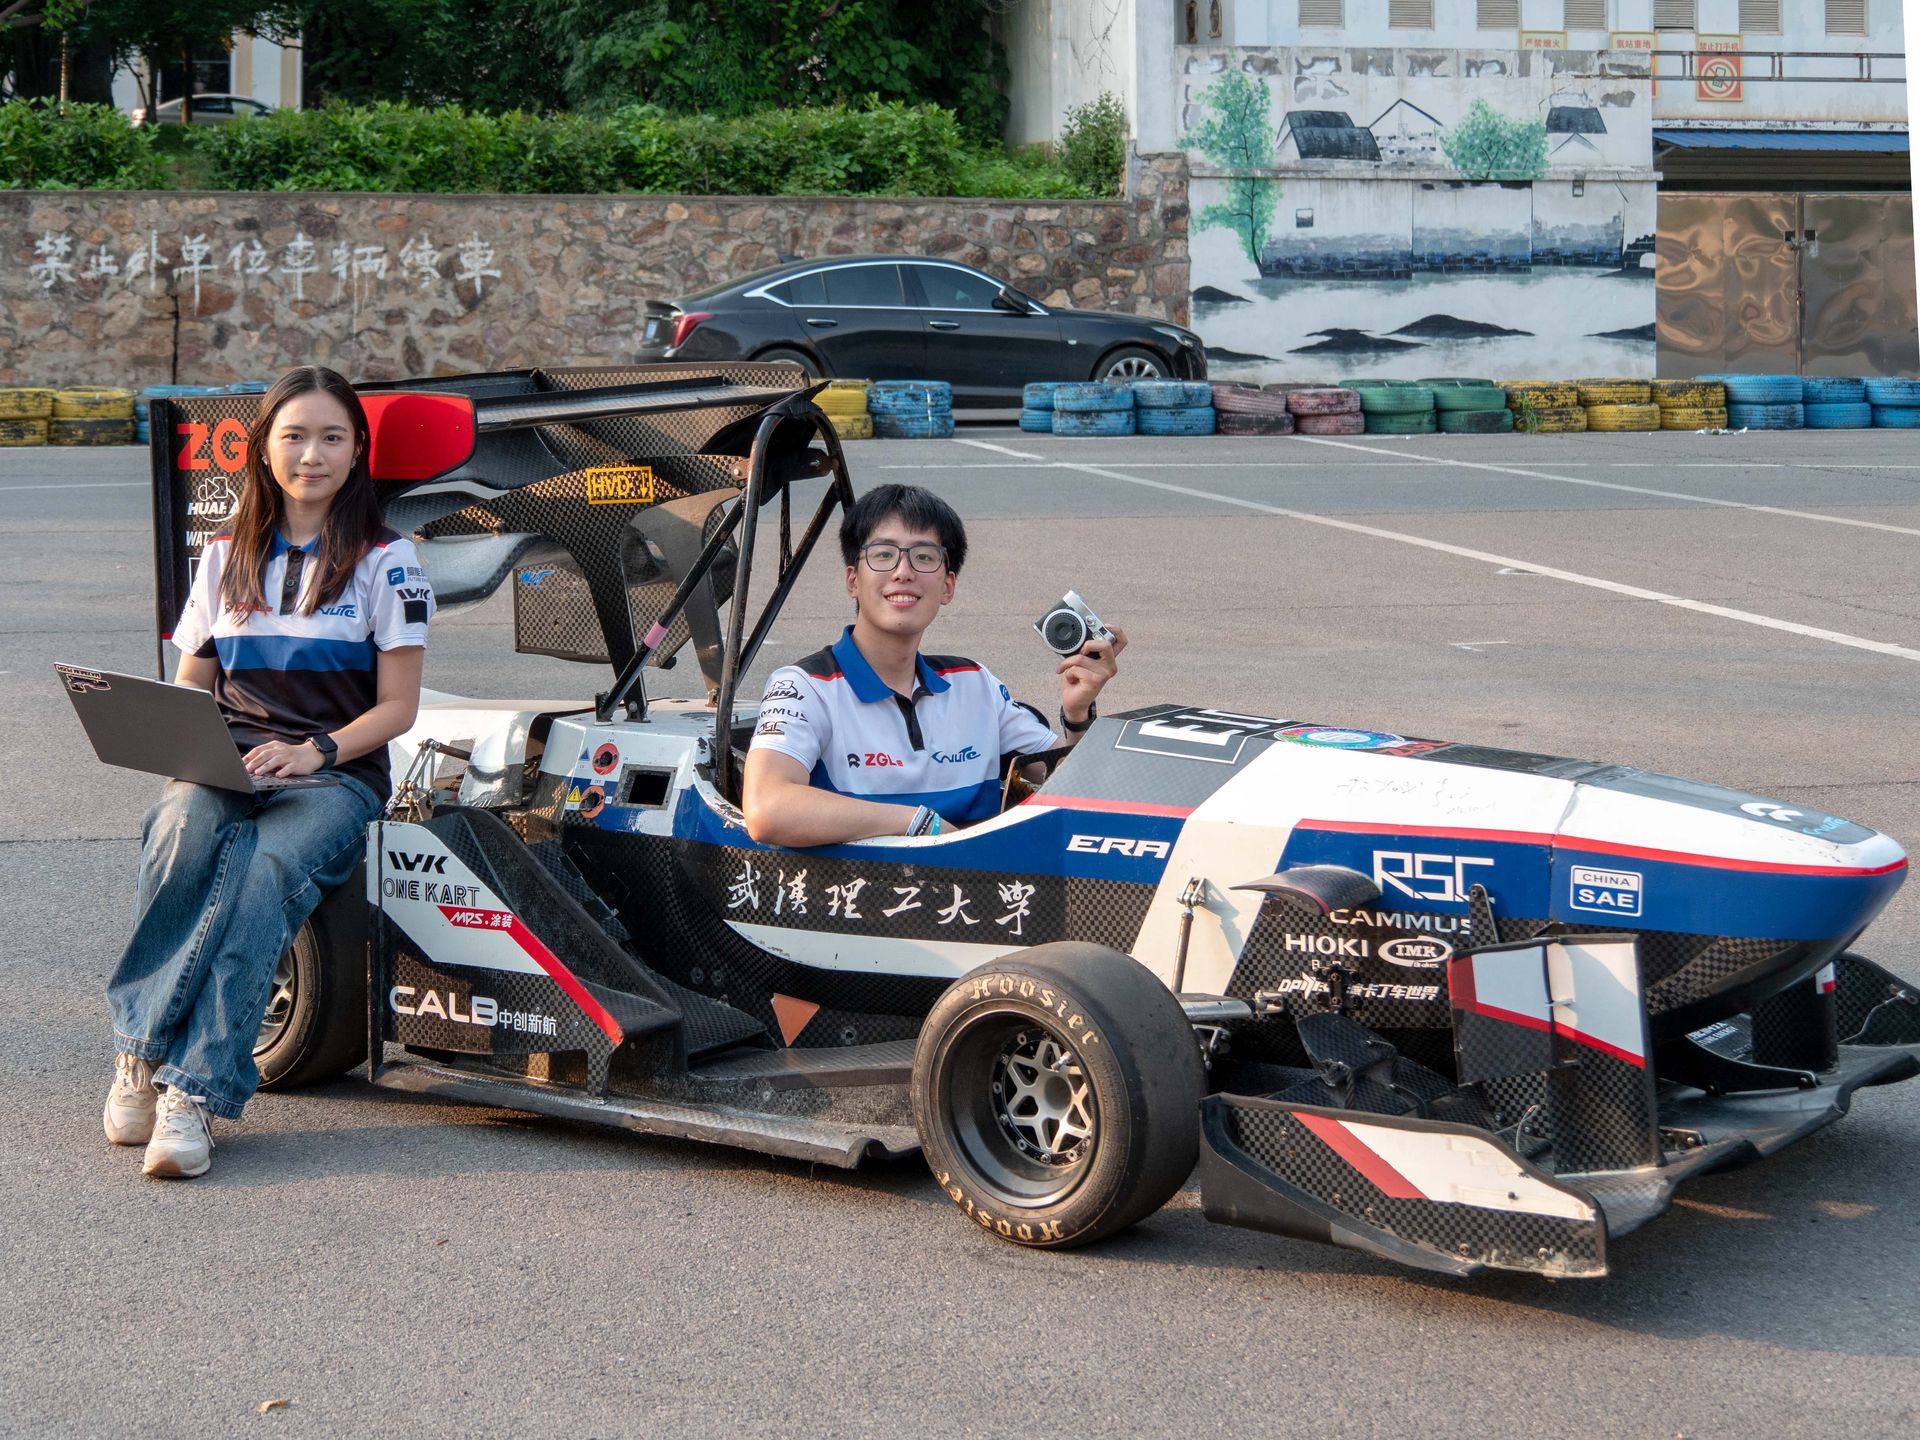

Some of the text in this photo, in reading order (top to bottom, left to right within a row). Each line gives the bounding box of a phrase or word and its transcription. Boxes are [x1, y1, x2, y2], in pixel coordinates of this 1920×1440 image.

[177, 418, 257, 472] ZG
[592, 475, 630, 497] HVD
[1066, 834, 1170, 859] ERA
[383, 878, 480, 907] ONE KART
[1582, 873, 1631, 887] CHINA
[1578, 888, 1634, 909] SAE
[1329, 908, 1472, 935] CAMMUS
[1285, 933, 1369, 957] HIOKI
[389, 985, 557, 1036] CALB 中创新航
